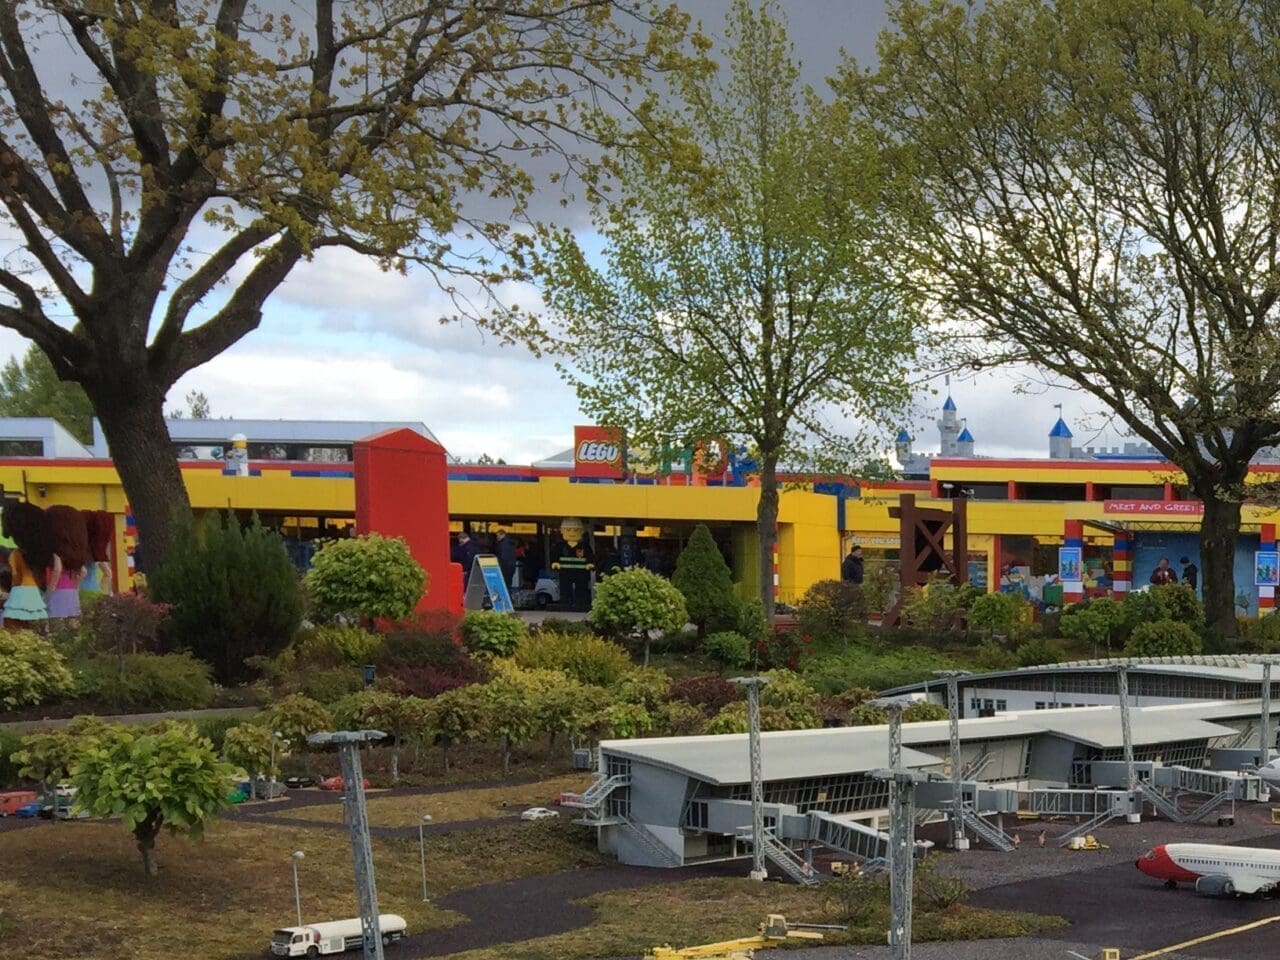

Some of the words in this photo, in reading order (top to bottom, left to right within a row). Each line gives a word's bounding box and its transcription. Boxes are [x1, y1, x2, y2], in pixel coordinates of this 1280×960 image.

[577, 441, 619, 462] LEGO
[1108, 503, 1136, 511] MEET
[1139, 503, 1161, 511] AND
